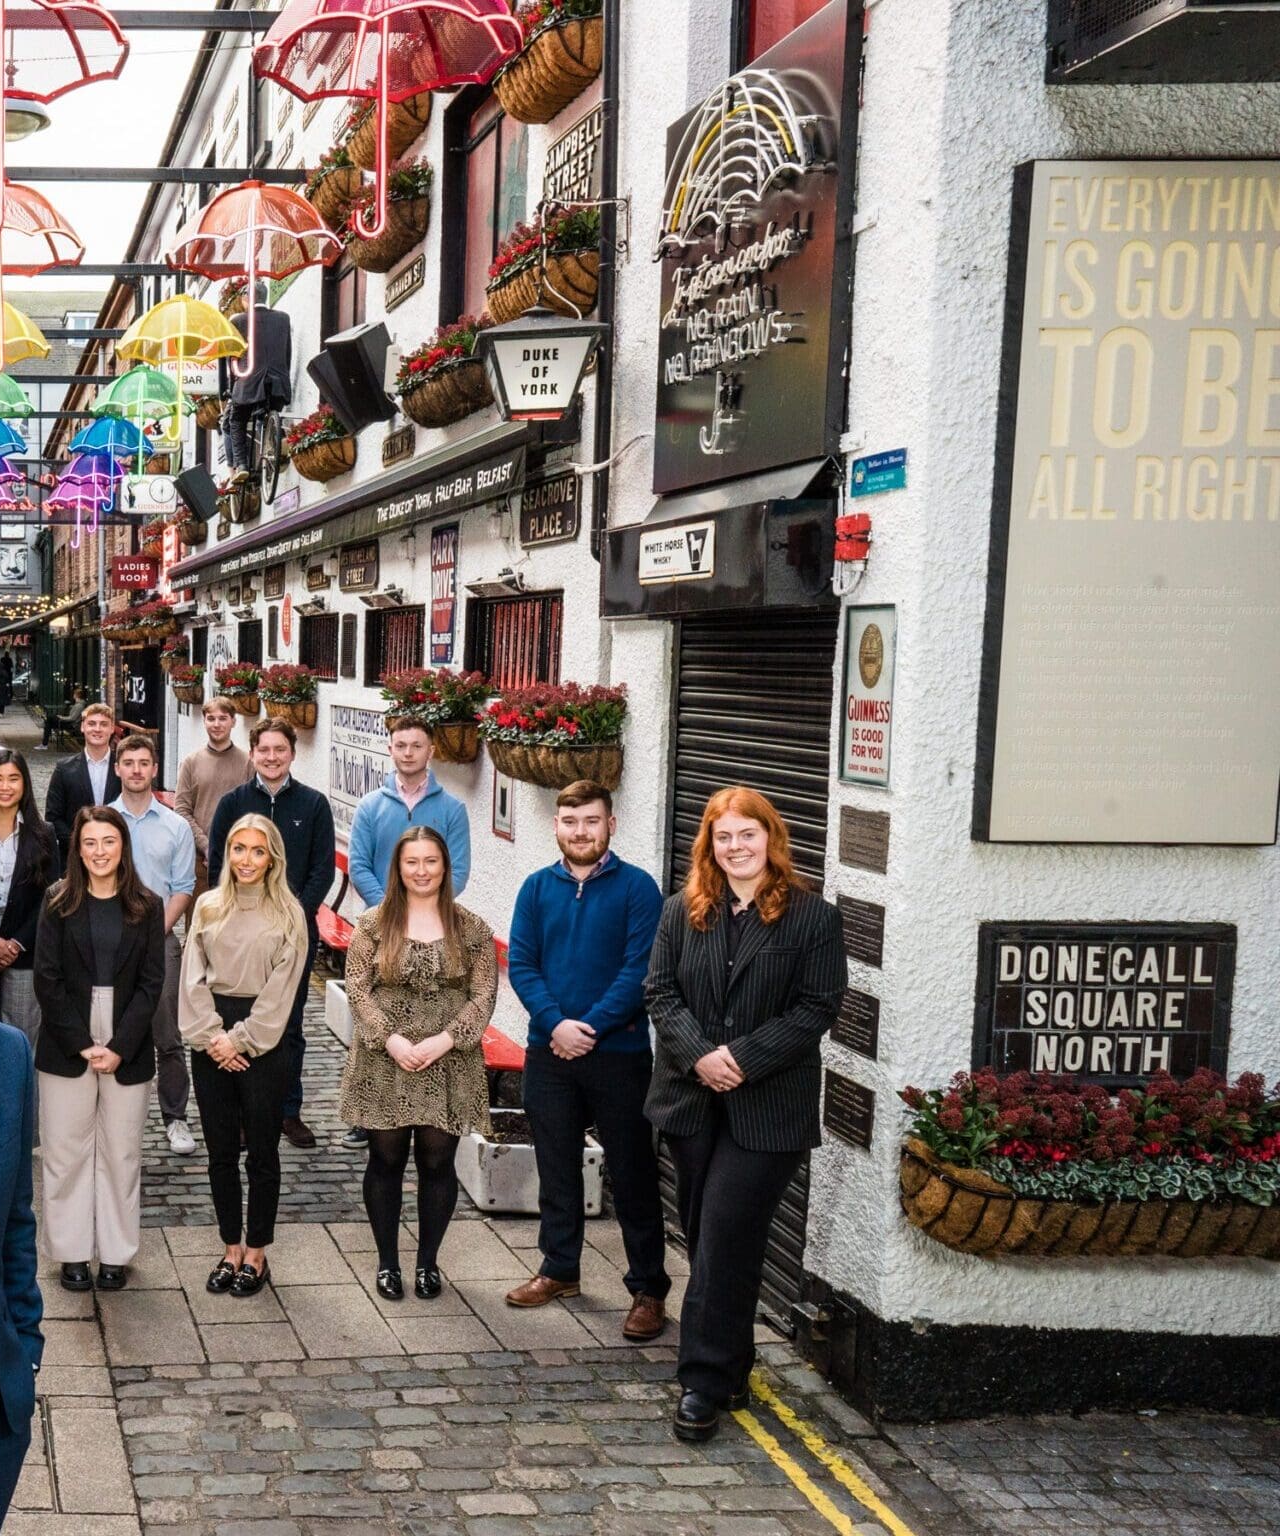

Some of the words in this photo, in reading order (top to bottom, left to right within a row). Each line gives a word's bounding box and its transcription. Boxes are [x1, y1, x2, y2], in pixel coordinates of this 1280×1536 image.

[545, 112, 602, 178] CAMPBELL
[548, 144, 596, 200] STREET
[1040, 239, 1100, 321] IS
[1115, 239, 1280, 321] GOIN
[686, 309, 712, 343] NO
[523, 348, 559, 361] DUKE
[664, 352, 692, 385] NO
[182, 375, 203, 385] BAR
[531, 366, 549, 378] OF
[520, 383, 558, 396] YORK
[1038, 326, 1155, 449] TO
[1181, 326, 1280, 449] BE
[377, 507, 389, 523] THE
[435, 484, 454, 504] HALF
[477, 462, 513, 490] BELFAST
[1027, 455, 1117, 522] ALL
[1133, 454, 1280, 522] RIGHT
[529, 511, 563, 540] PLACE
[431, 530, 455, 566] PARK
[645, 542, 663, 553] WHITE
[664, 539, 684, 551] HORSE
[118, 563, 151, 572] LADIES
[120, 573, 148, 582] ROOM
[346, 567, 366, 585] STREET
[432, 567, 455, 599] DRIVE
[848, 695, 890, 724] GUINNESS
[852, 727, 859, 741] IS
[861, 728, 884, 744] GOOD
[851, 744, 866, 757] FOR
[868, 745, 883, 760] YOU
[1025, 990, 1185, 1029] SQUARE
[1035, 1035, 1170, 1072] NORTH
